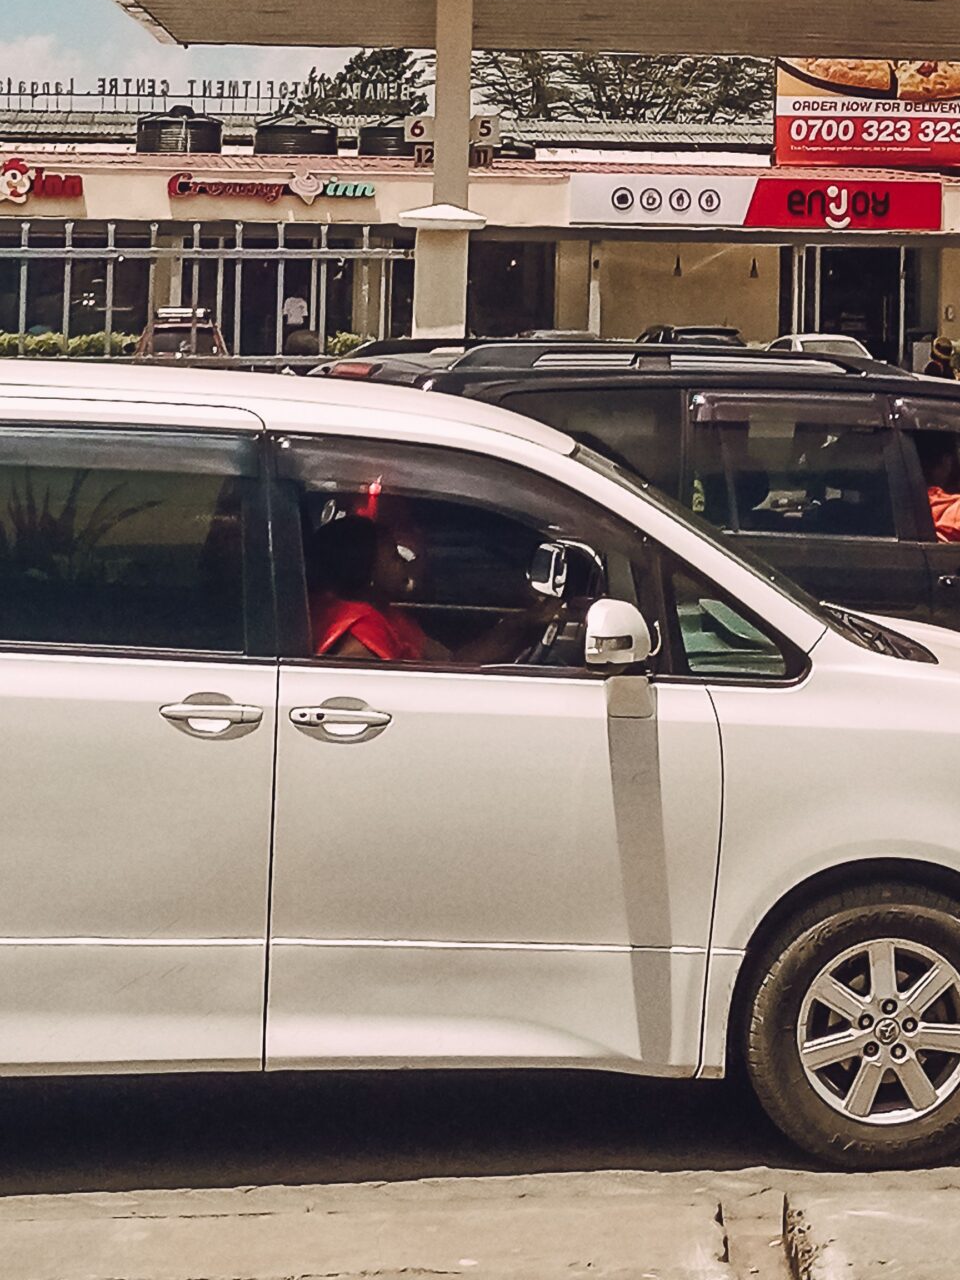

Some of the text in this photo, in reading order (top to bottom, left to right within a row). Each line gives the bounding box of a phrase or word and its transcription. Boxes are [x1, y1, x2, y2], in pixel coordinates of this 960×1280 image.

[792, 100, 837, 112] ORDER
[841, 101, 872, 113] NOW
[875, 101, 900, 113] FOR
[410, 120, 425, 137] 6
[479, 120, 492, 137] 5
[790, 119, 855, 141] 0700
[861, 120, 911, 142] 323
[416, 148, 434, 163] 12
[326, 176, 376, 198] inn
[787, 185, 890, 218] enjoy
